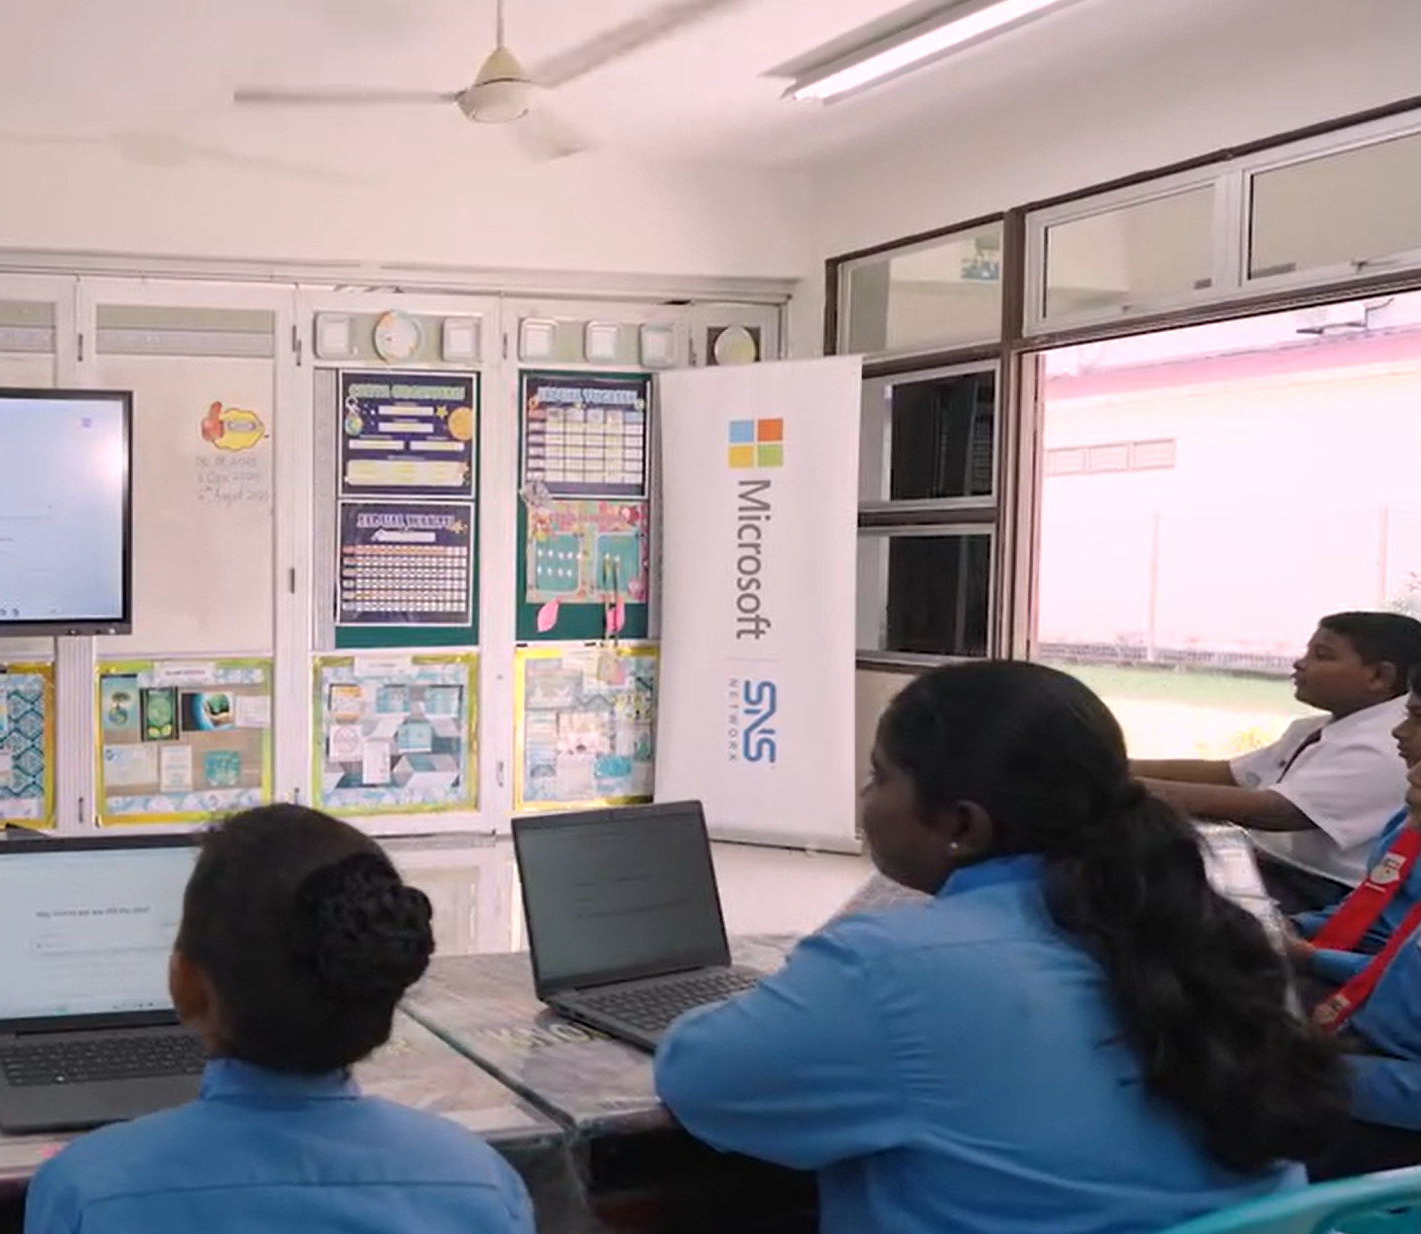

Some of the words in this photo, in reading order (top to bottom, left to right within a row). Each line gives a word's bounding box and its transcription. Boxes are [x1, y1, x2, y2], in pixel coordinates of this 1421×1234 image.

[735, 479, 772, 640] Microsoft
[728, 677, 740, 762] NETWORK
[743, 680, 777, 763] SNS
